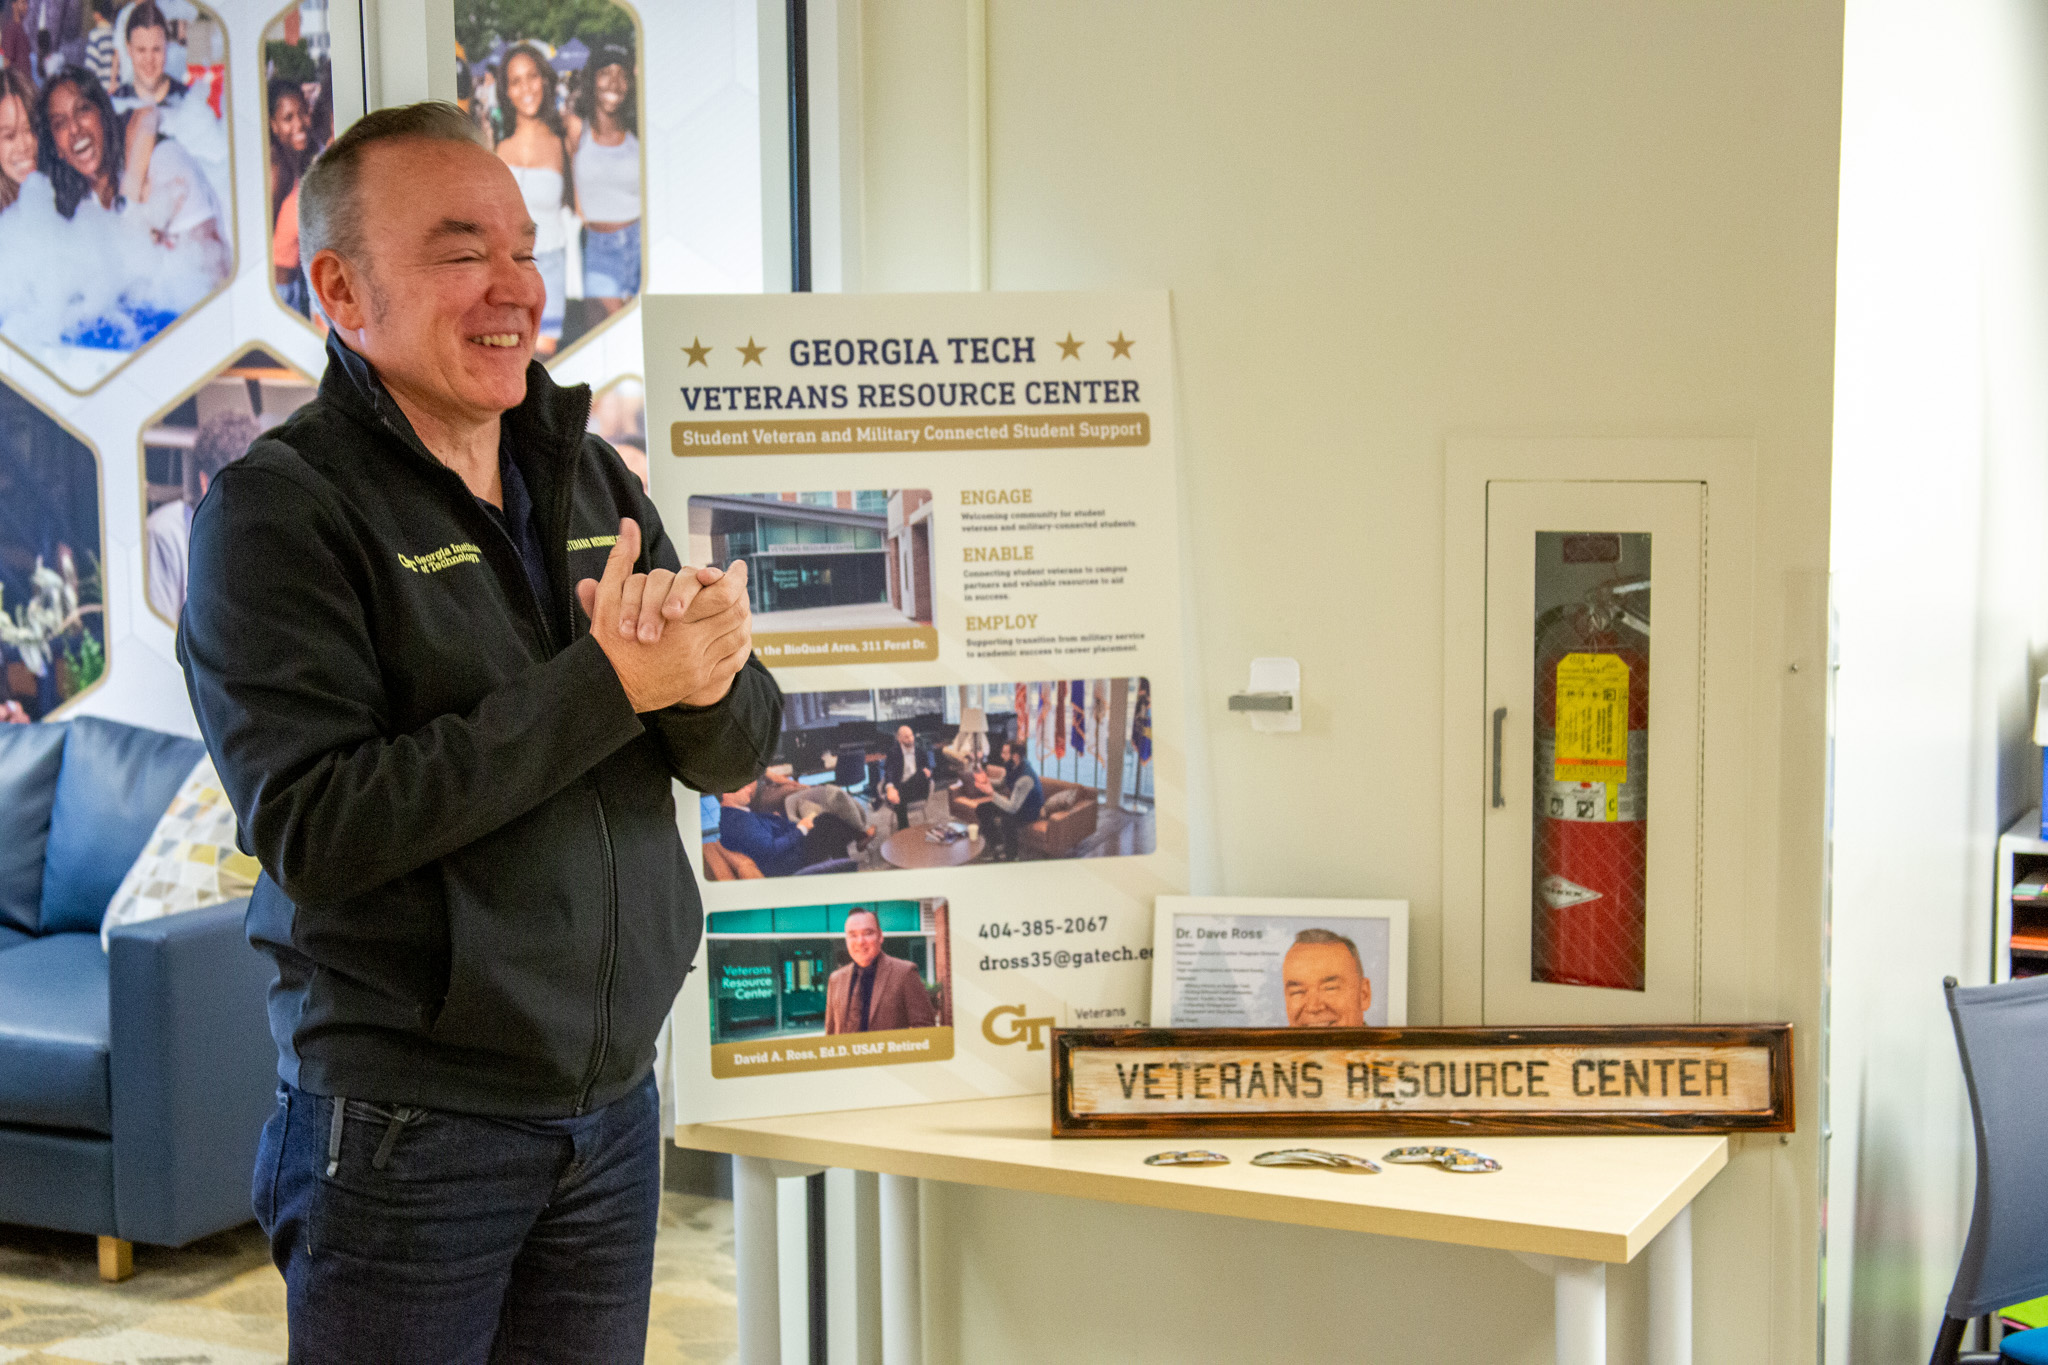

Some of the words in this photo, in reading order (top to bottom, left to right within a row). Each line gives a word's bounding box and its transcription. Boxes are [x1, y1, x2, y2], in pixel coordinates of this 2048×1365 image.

[790, 338, 939, 366] GEORGIA
[948, 336, 1035, 364] TECH
[681, 385, 848, 411] VETERANS
[858, 382, 1016, 408] RESOURCE
[1025, 379, 1140, 405] CENTER
[683, 429, 748, 445] Student
[752, 429, 816, 444] Veteran
[821, 427, 852, 442] and
[857, 424, 920, 444] Military
[924, 424, 1008, 441] Connected
[1013, 422, 1075, 439] Student
[1079, 421, 1142, 439] Support
[960, 488, 1033, 505] ENGAGE
[414, 547, 451, 565] Georgia
[962, 545, 1035, 562] ENABLE
[420, 564, 430, 574] of
[428, 552, 480, 573] Technology
[965, 613, 1039, 631] EMPLOY
[764, 643, 782, 655] the
[784, 640, 829, 655] BioQuad
[862, 640, 881, 650] 311
[883, 638, 911, 650] Ferst
[913, 637, 928, 649] Dr.
[978, 916, 1108, 939] 404-385-2067
[1176, 928, 1193, 939] Dr.
[1197, 928, 1227, 939] Dave
[1231, 928, 1263, 939] Ross
[723, 965, 772, 975] Veterans
[722, 977, 773, 988] Resource
[735, 989, 773, 1000] Center
[1074, 1007, 1126, 1020] Veterans
[981, 1004, 1056, 1051] GT
[733, 1053, 768, 1065] David
[771, 1051, 784, 1062] A.
[852, 1043, 885, 1056] USAF
[887, 1039, 930, 1054] Retired
[1115, 1061, 1324, 1099] VETERANS
[1347, 1060, 1550, 1098] RESOURCE
[1572, 1059, 1729, 1097] CENTER
